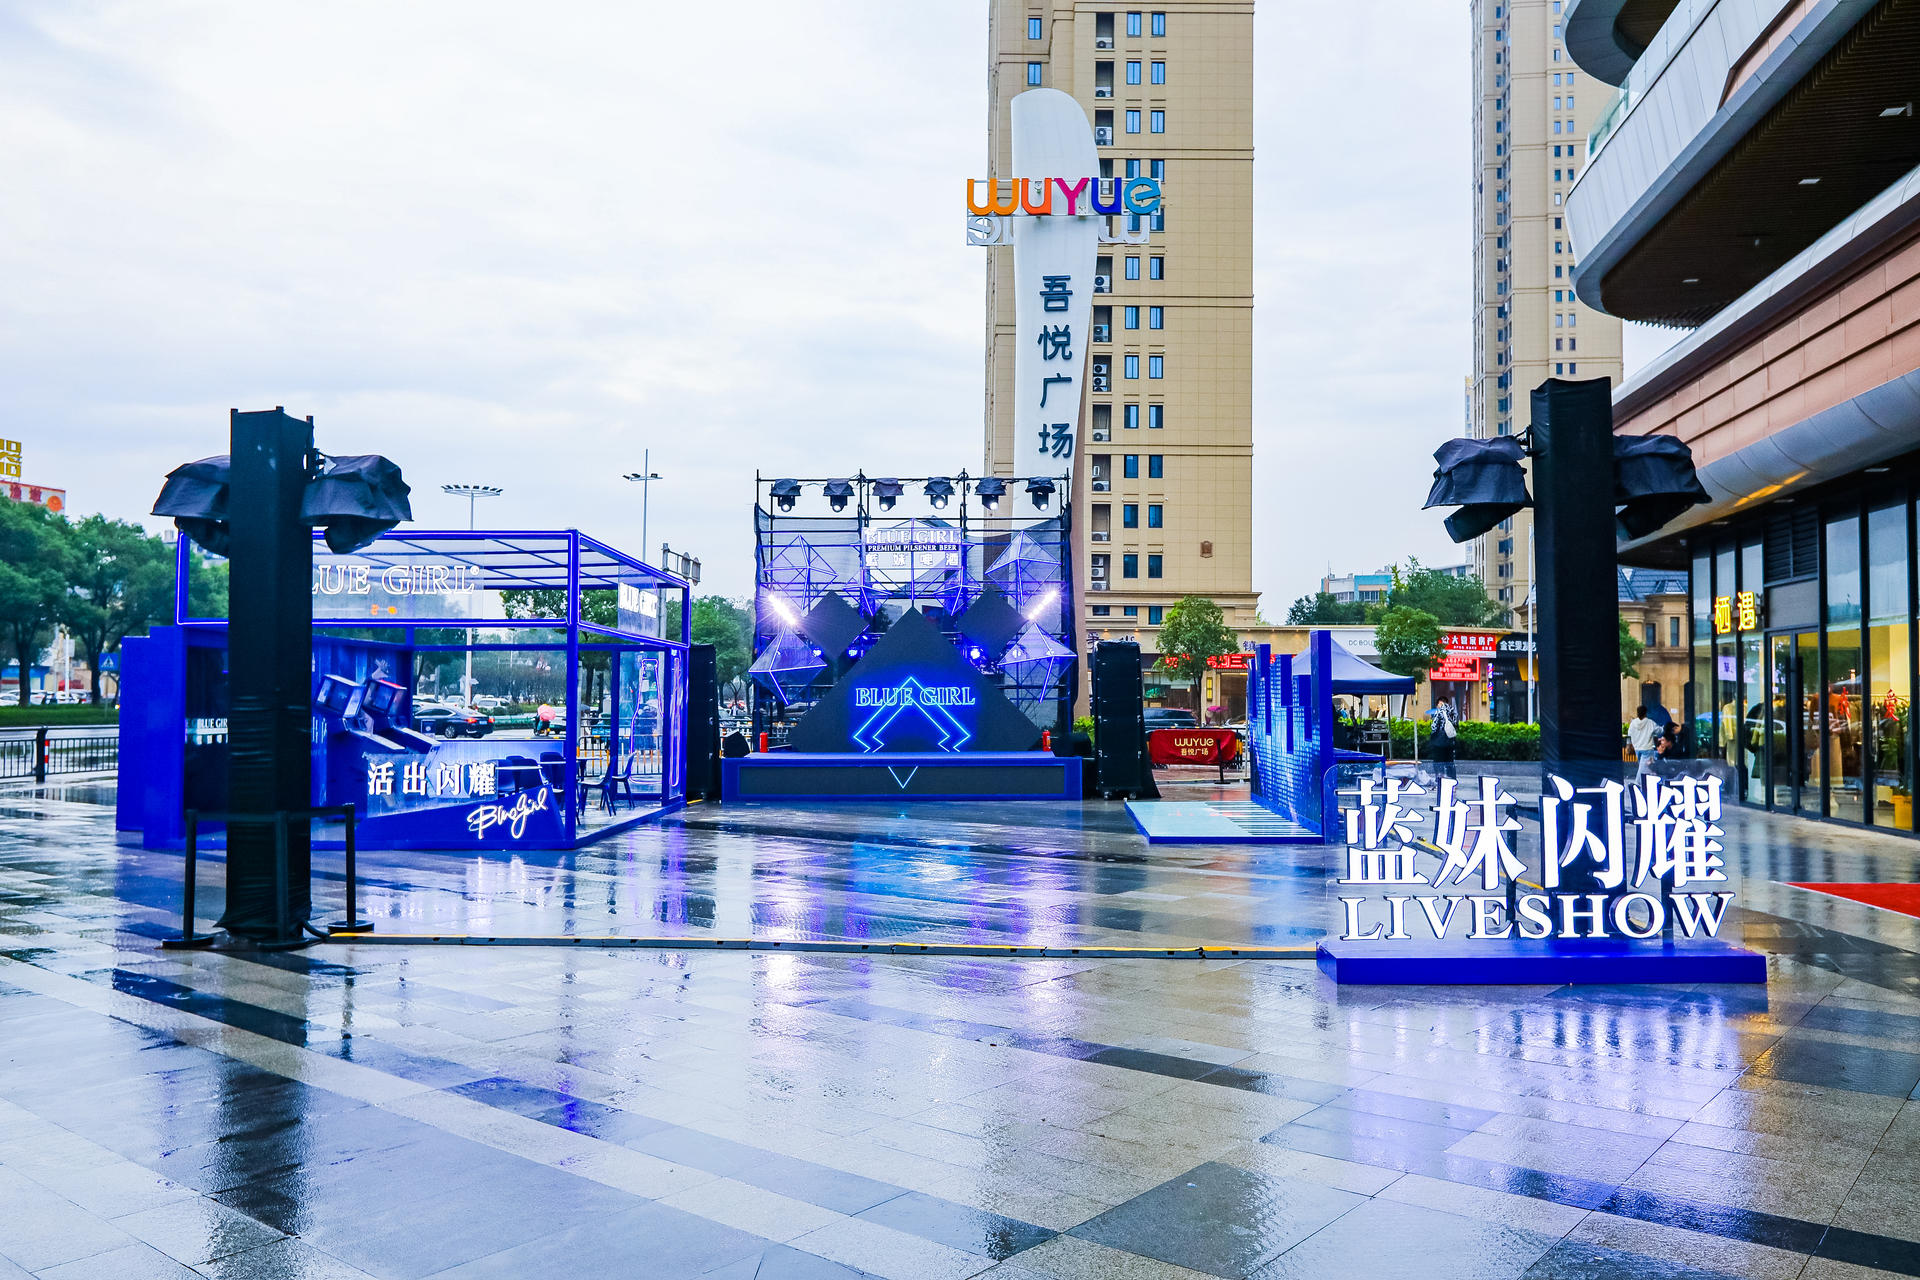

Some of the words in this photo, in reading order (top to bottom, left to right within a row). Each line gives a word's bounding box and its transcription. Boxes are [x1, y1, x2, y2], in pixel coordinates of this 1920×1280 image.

[1037, 275, 1073, 458] 吾悦广场
[864, 529, 910, 544] BLUE
[1714, 591, 1755, 635] 栖遇
[856, 688, 913, 706] BLUE
[919, 687, 976, 705] GIRL
[367, 761, 497, 796] 活出闪耀
[1335, 774, 1728, 890] 蓝妹闪耀
